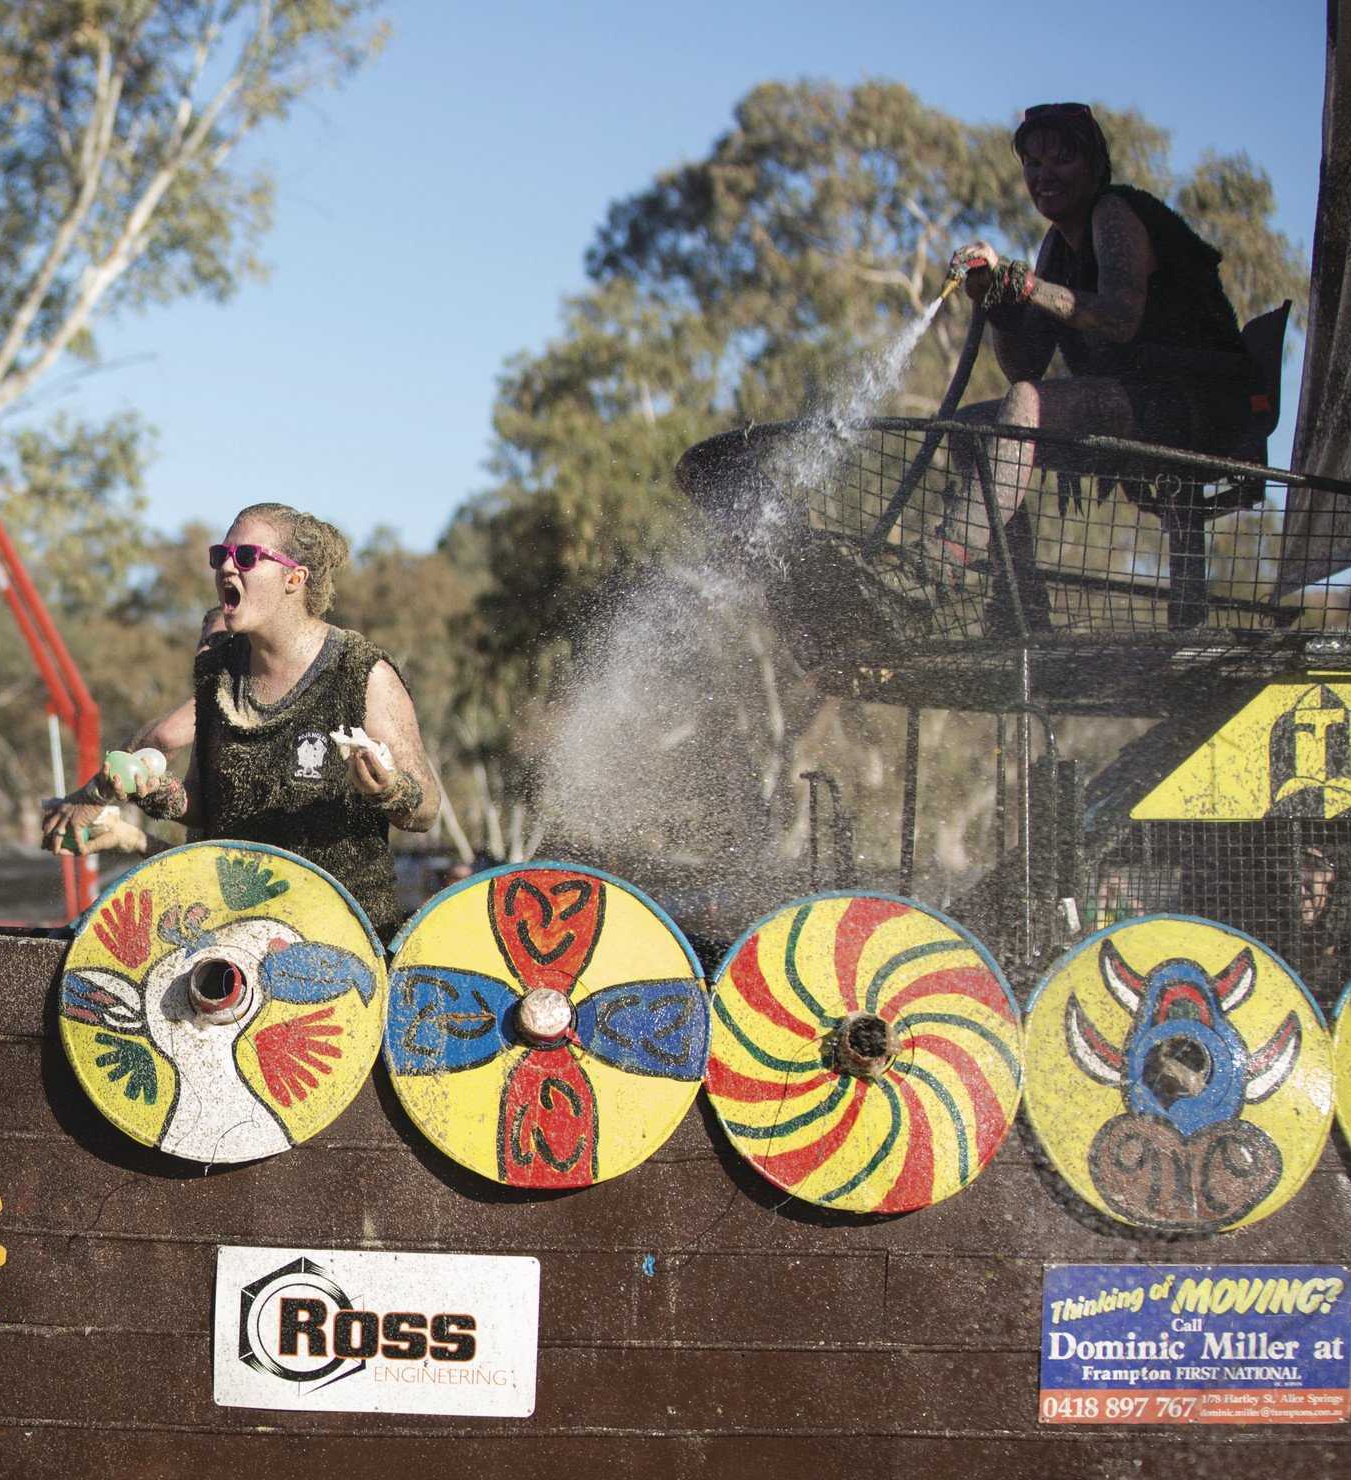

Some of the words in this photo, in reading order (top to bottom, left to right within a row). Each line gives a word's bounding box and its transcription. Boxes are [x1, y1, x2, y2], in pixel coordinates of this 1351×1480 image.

[1050, 1287, 1145, 1325] Thinking
[1149, 1273, 1176, 1301] of
[1171, 1276, 1345, 1315] MOVING?
[278, 1296, 477, 1362] ROSS
[1171, 1318, 1203, 1333] Call
[1048, 1332, 1186, 1361] Dominic
[1200, 1332, 1300, 1361] Miller
[1313, 1338, 1345, 1361] at
[373, 1365, 508, 1387] ENGINEERING
[1082, 1365, 1172, 1386] Frampton
[1176, 1366, 1220, 1381] FIRST
[1223, 1366, 1302, 1381] NATIONAL
[1042, 1397, 1099, 1418] 0418
[1105, 1397, 1149, 1418] 897
[1156, 1397, 1197, 1418] 767
